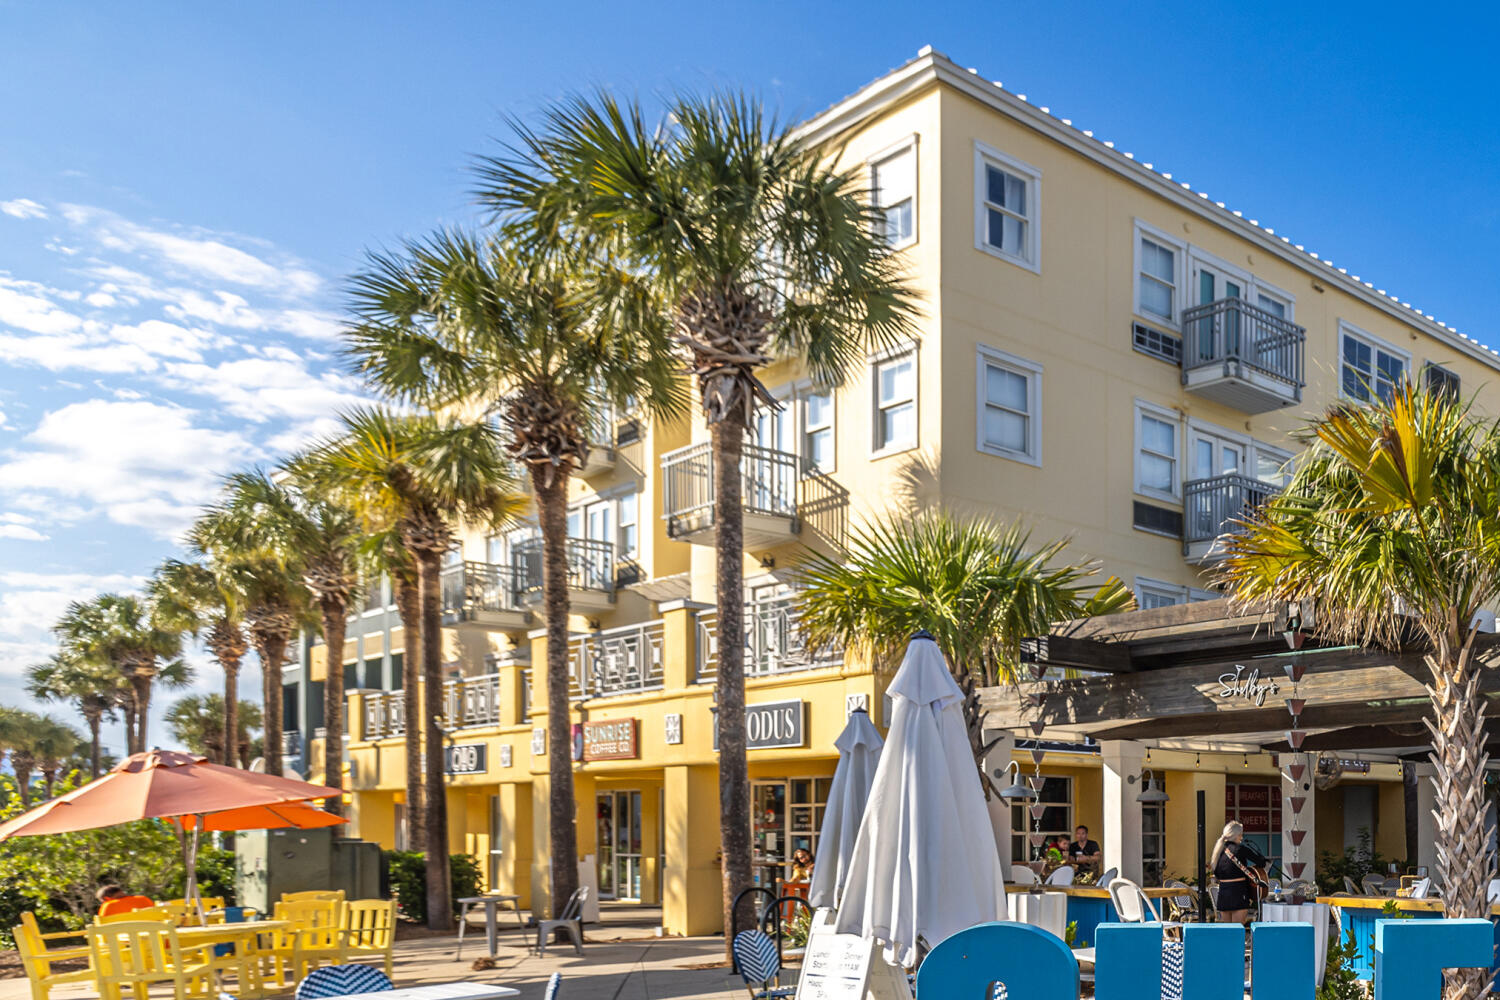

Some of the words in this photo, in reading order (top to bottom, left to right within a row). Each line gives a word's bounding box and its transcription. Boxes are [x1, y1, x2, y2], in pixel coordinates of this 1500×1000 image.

[1218, 664, 1280, 707] Shelby's
[584, 722, 631, 744] SUNRISE
[744, 707, 795, 742] ODUS
[590, 743, 617, 755] COFFEE
